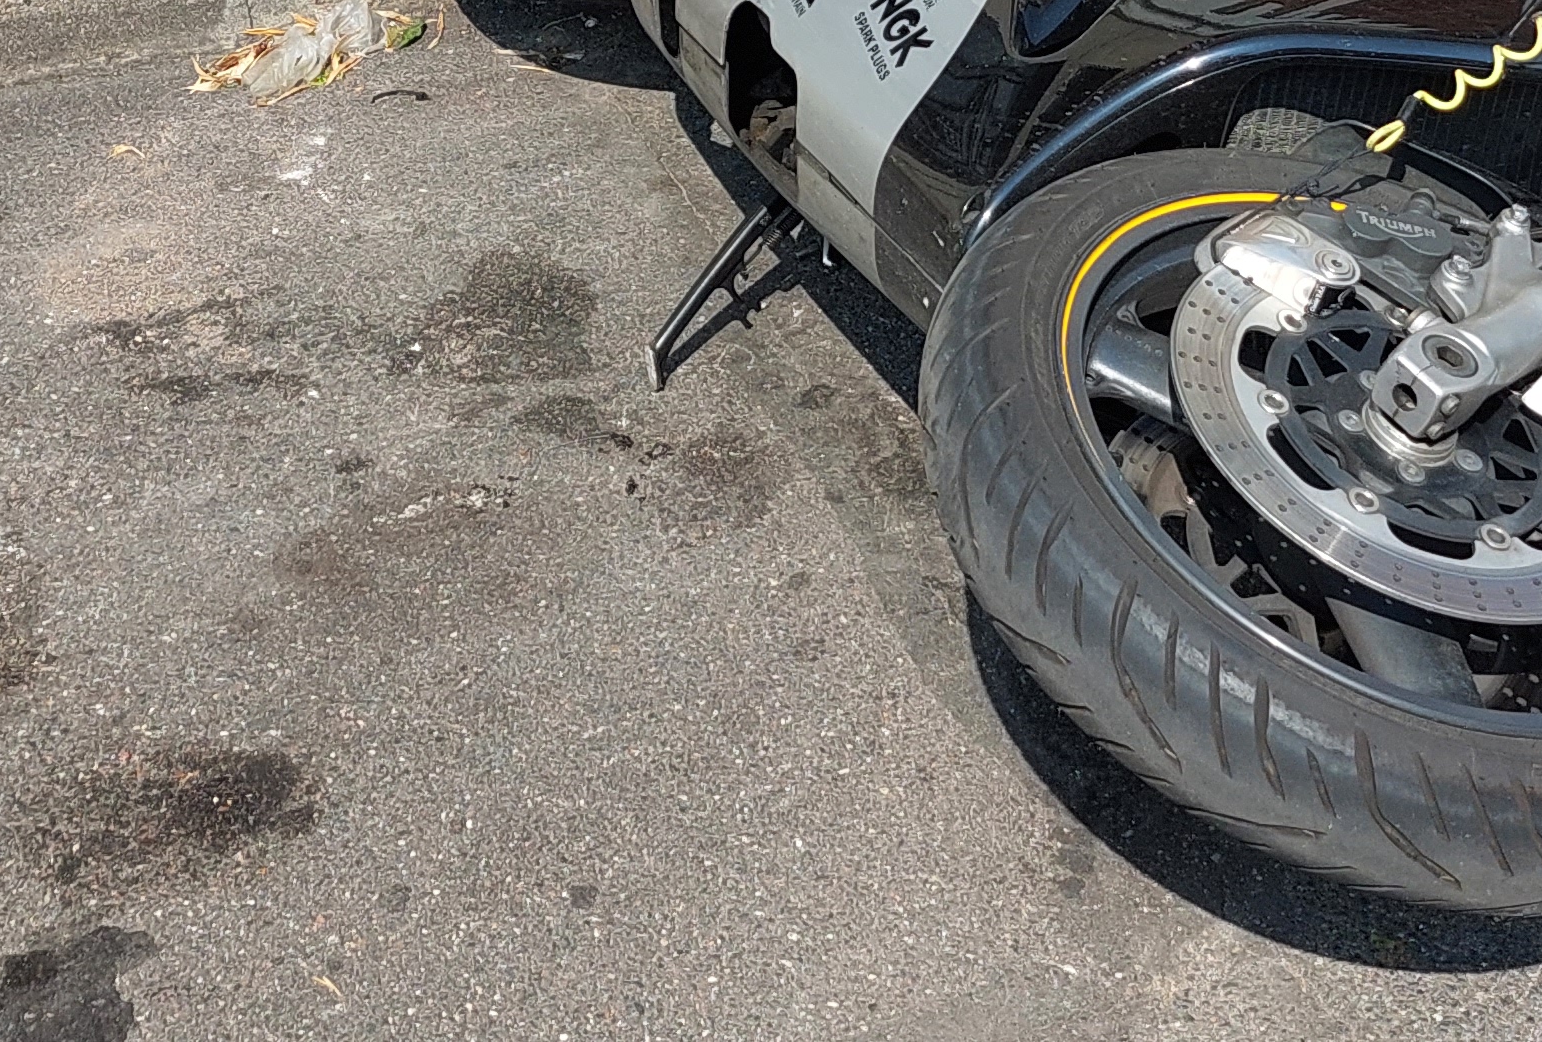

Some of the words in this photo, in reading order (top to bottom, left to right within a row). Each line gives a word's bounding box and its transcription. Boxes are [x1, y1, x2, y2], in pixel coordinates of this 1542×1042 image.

[854, 11, 877, 47] SPARK
[867, 43, 891, 82] PLUGS
[1356, 209, 1437, 238] TRIUMPH
